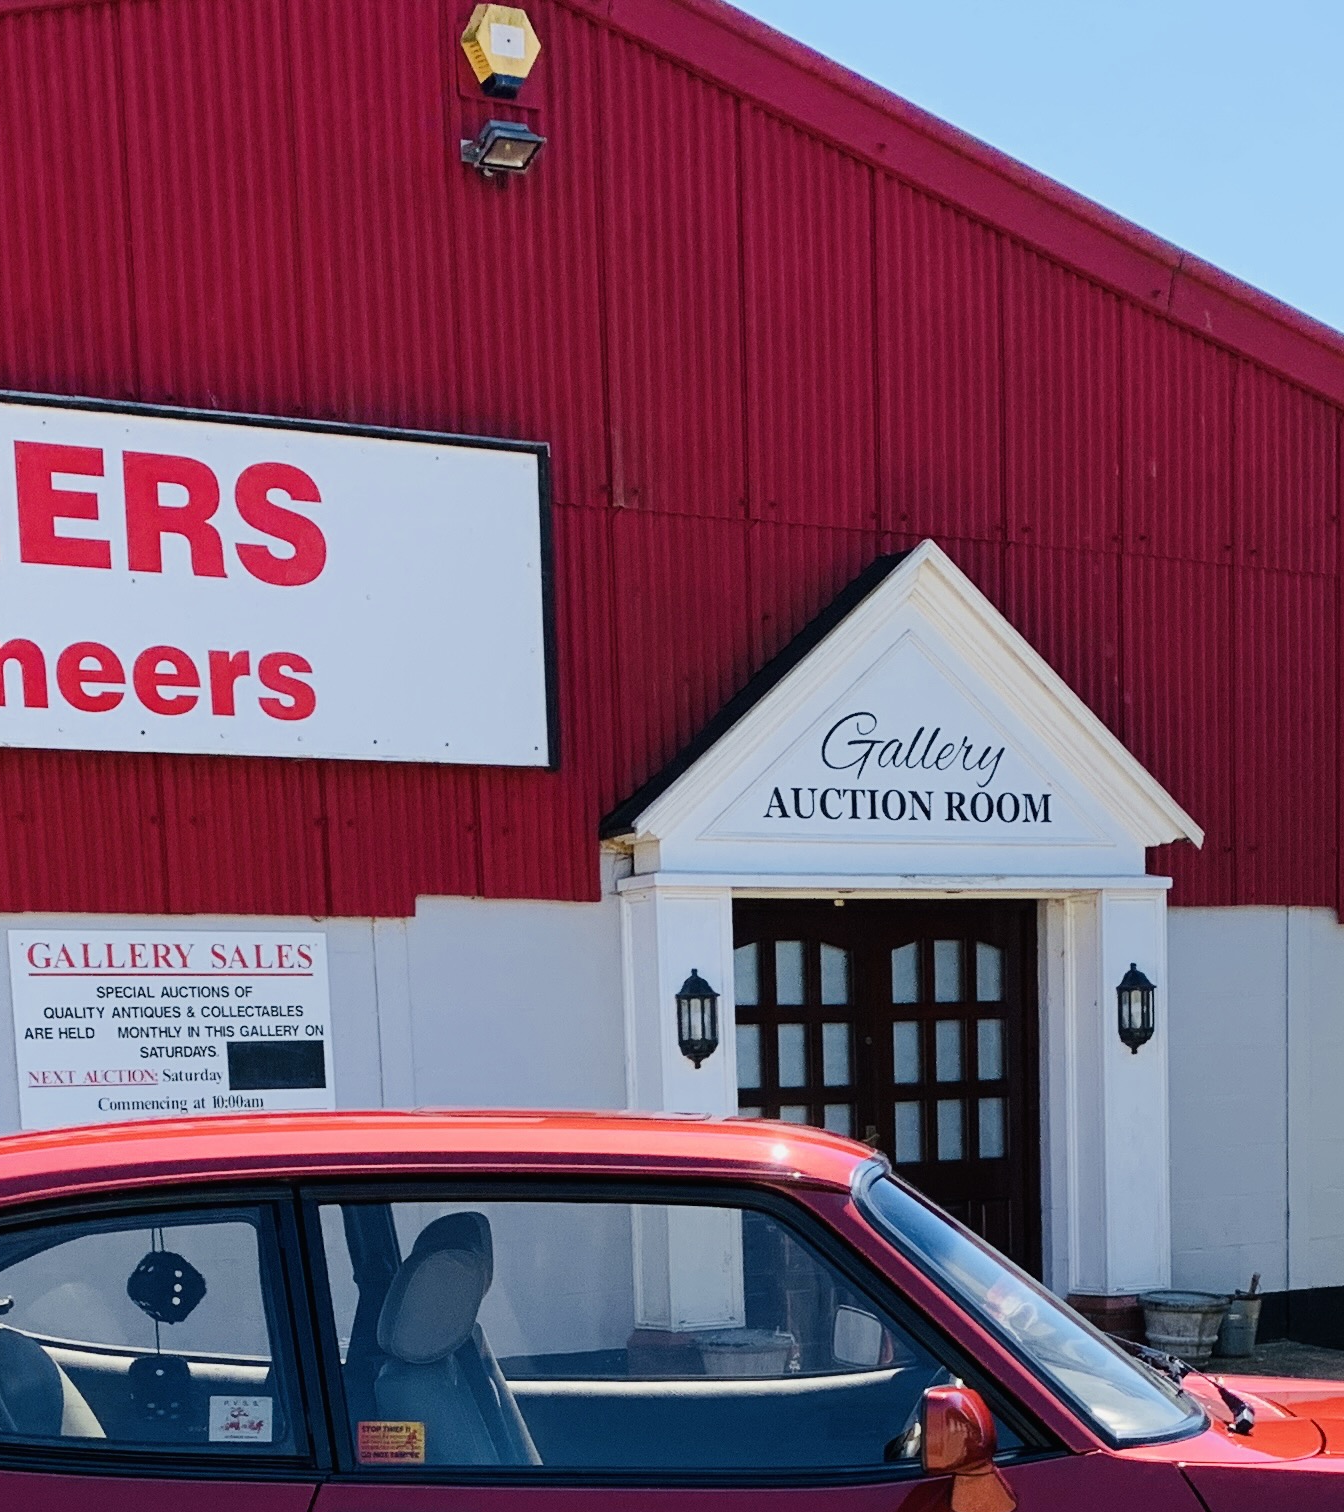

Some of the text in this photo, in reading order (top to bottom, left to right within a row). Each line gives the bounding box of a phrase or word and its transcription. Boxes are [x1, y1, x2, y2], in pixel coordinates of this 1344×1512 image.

[821, 711, 1006, 788] Gallery
[763, 786, 1053, 823] AUCTION ROOM
[26, 942, 313, 970] GALLERY SALES
[96, 985, 253, 999] SPECIAL AUCTIONS OF
[43, 1004, 304, 1020] QUALITY ANTIQUES & COLLECTABLES
[24, 1024, 324, 1040] ARE HELD MONTHLY IN THIS GALLERY ON
[139, 1045, 219, 1059] SATURDAYS.
[27, 1068, 223, 1084] NEXT AUCTION: Saturday
[97, 1094, 264, 1113] Commencing at 10:00am
